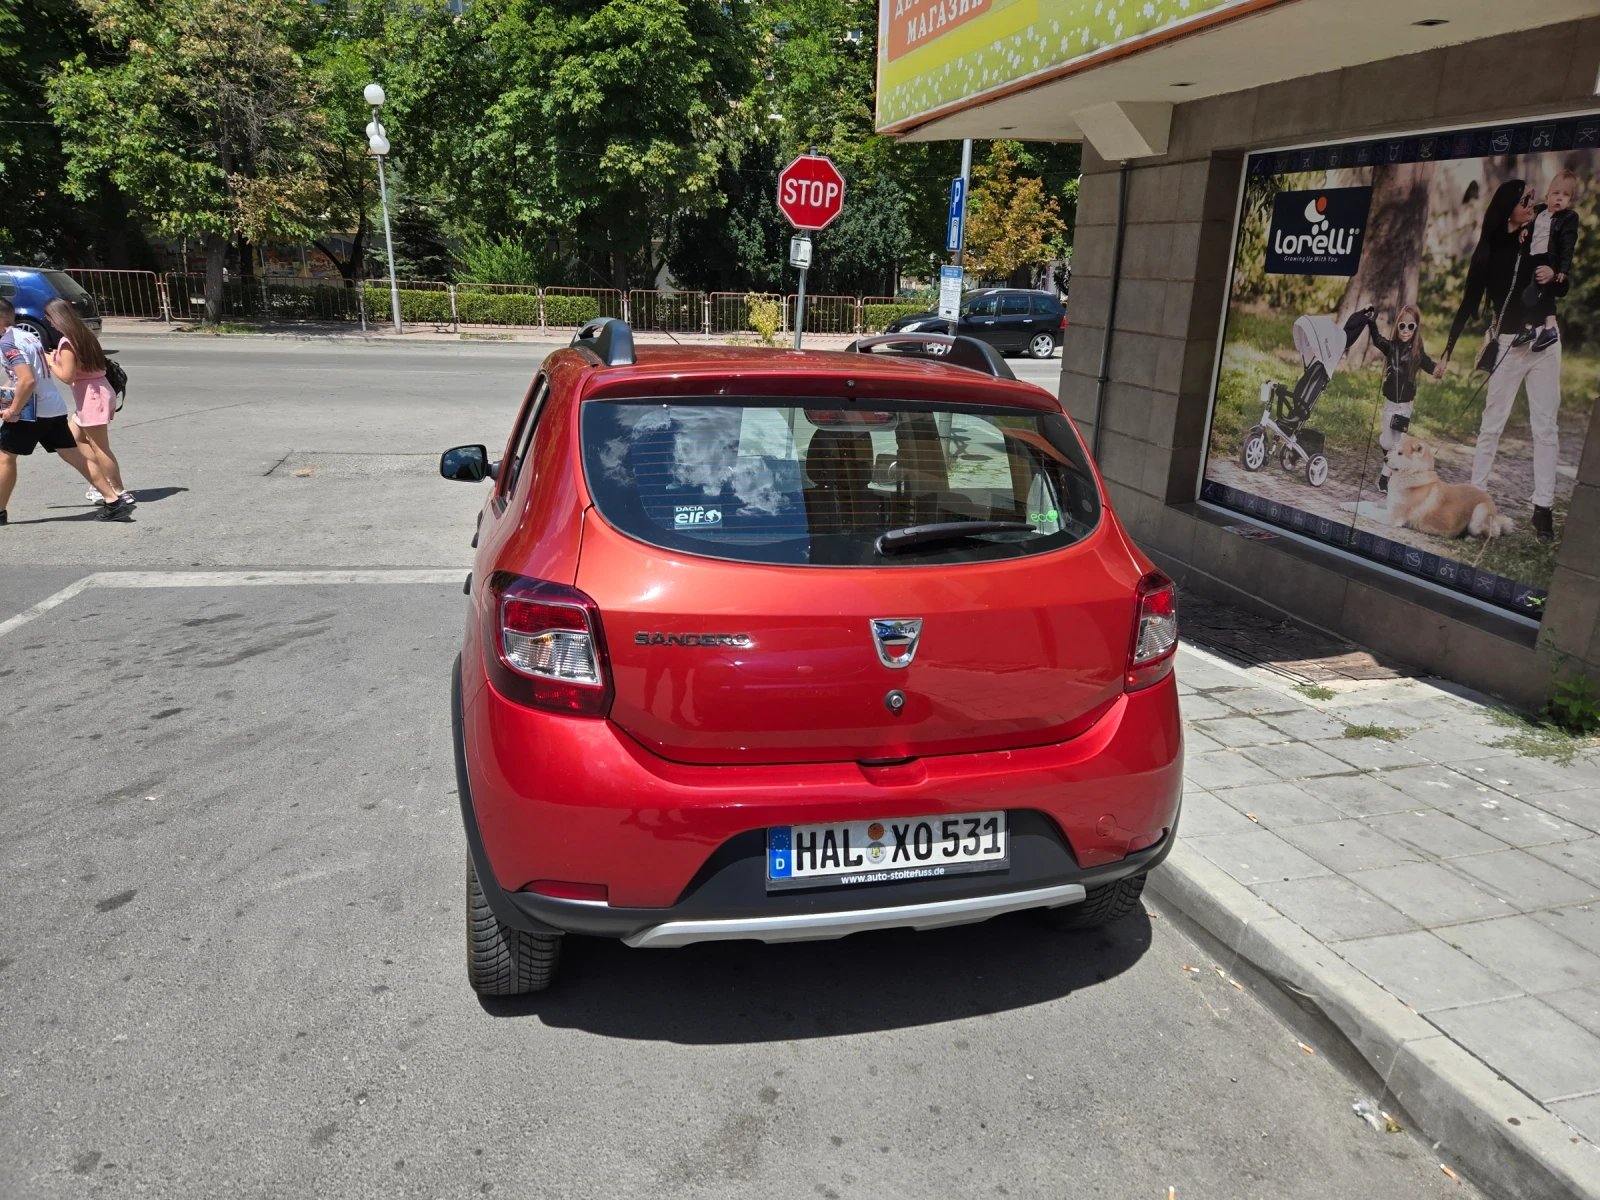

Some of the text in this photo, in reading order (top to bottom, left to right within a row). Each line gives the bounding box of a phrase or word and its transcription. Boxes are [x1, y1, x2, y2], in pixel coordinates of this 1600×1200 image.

[784, 178, 838, 208] STOP
[1284, 255, 1306, 263] Growing
[675, 511, 704, 523] elf
[635, 631, 753, 647] SANDERO
[796, 817, 1001, 871] HAL XO 531
[776, 858, 785, 870] D
[841, 867, 945, 884] www.auto-stoltefuss.de
